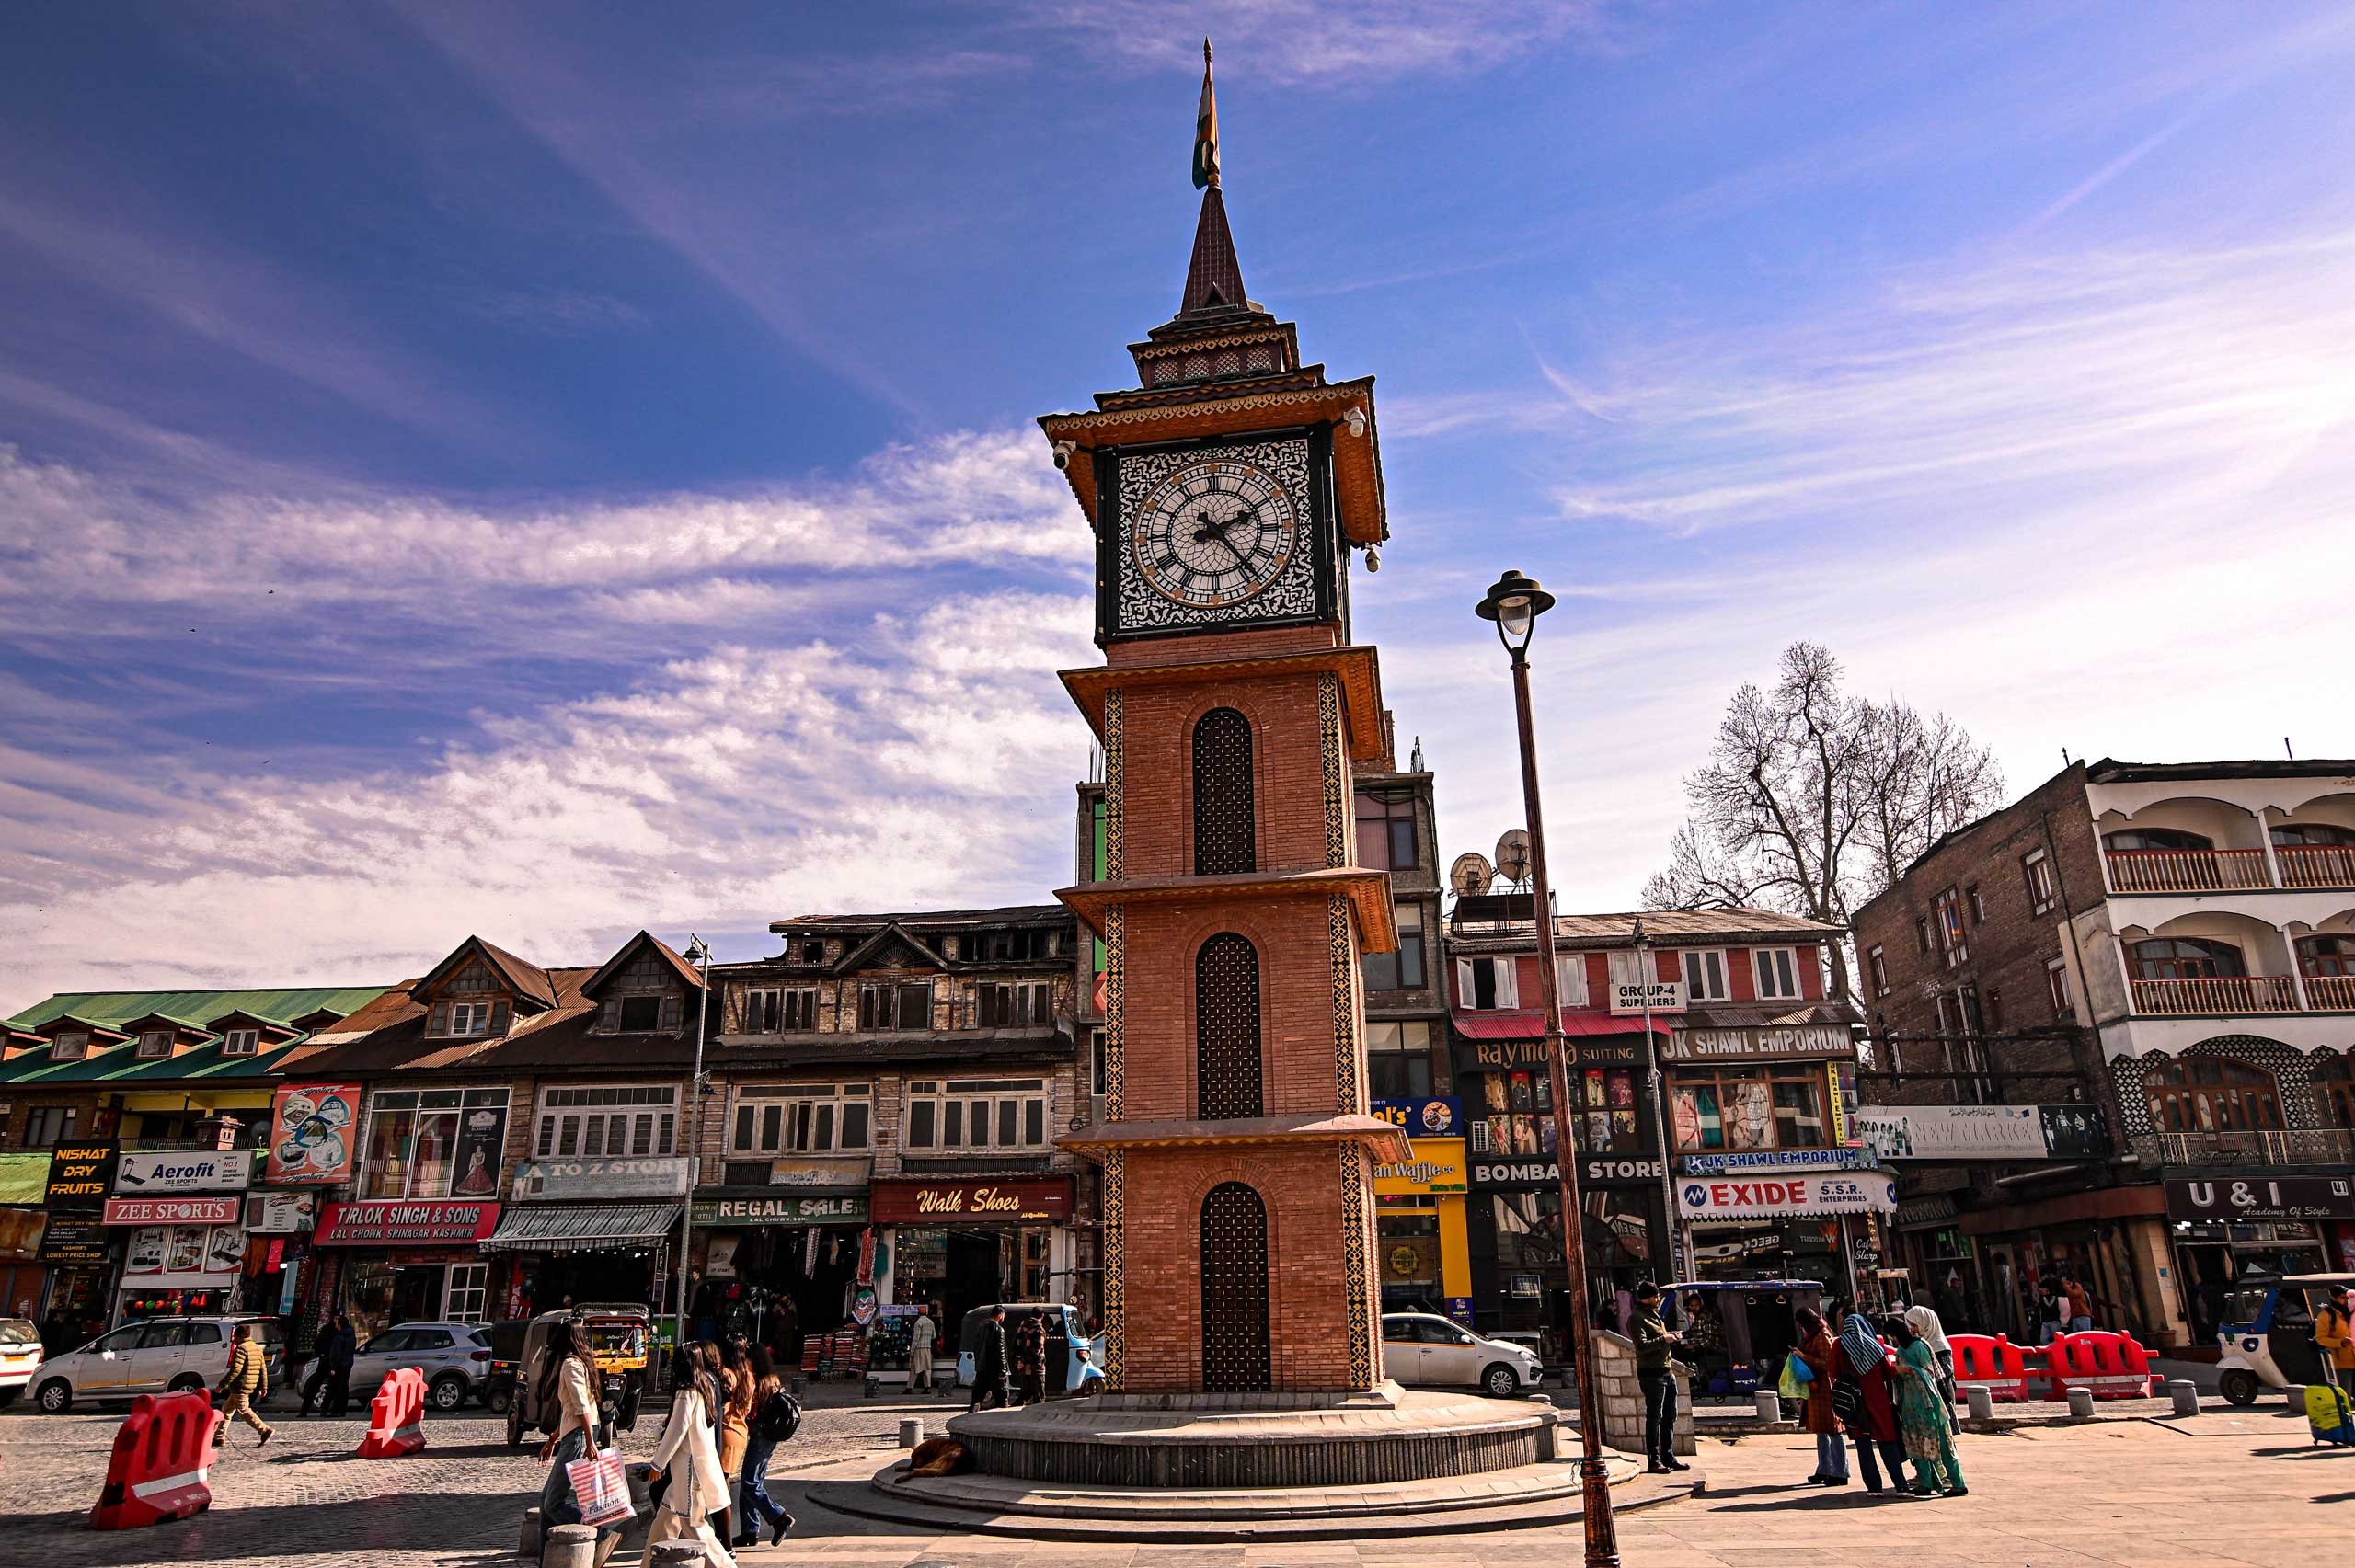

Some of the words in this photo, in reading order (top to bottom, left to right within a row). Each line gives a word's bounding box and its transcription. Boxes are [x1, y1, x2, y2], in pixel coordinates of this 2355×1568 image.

[1619, 985, 1675, 997] GROUP-4
[1662, 1031, 1691, 1058] JK
[1695, 1031, 1754, 1054] SHAWL
[1758, 1028, 1851, 1052] EMPORIUM
[1476, 1039, 1577, 1069] Raymod
[1582, 1047, 1634, 1060] SUITING
[56, 1148, 110, 1161] NISHAT
[1706, 1155, 1724, 1168] JK
[1729, 1153, 1776, 1166] SHAWL
[1781, 1150, 1856, 1164] EMPORIUM
[63, 1165, 97, 1177] DRY
[151, 1162, 215, 1179] Aerofit
[524, 1165, 544, 1177] A
[550, 1164, 583, 1176] TO
[589, 1162, 604, 1175] Z
[1395, 1162, 1441, 1183] Waffle
[1476, 1164, 1562, 1181] BOMBA
[1588, 1161, 1663, 1179] STORE
[50, 1183, 104, 1194] FRUITS
[1709, 1181, 1807, 1207] EXIDE
[1821, 1185, 1862, 1195] S.S.R.
[2188, 1183, 2215, 1207] U
[2230, 1181, 2257, 1207] &
[2268, 1181, 2281, 1207] I
[719, 1200, 788, 1218] REGAL
[800, 1198, 854, 1217] SALE
[916, 1190, 963, 1214] Walk
[971, 1186, 1020, 1212] Shoes
[116, 1205, 153, 1219] ZEE
[156, 1203, 225, 1219] SPORTS
[337, 1207, 385, 1225] TIRLOK
[388, 1207, 430, 1224] SINGH
[432, 1207, 442, 1223] &
[443, 1207, 480, 1224] SONS
[2241, 1207, 2285, 1218] Academy
[2289, 1207, 2301, 1218] Of
[2304, 1206, 2331, 1216] Style
[329, 1229, 347, 1240] LAL
[351, 1229, 383, 1239] CHOWK
[387, 1229, 429, 1238] SRINAGAR
[432, 1229, 474, 1238] KASHMIR
[1856, 1238, 1870, 1250] Caf
[1855, 1250, 1878, 1262] Slurp
